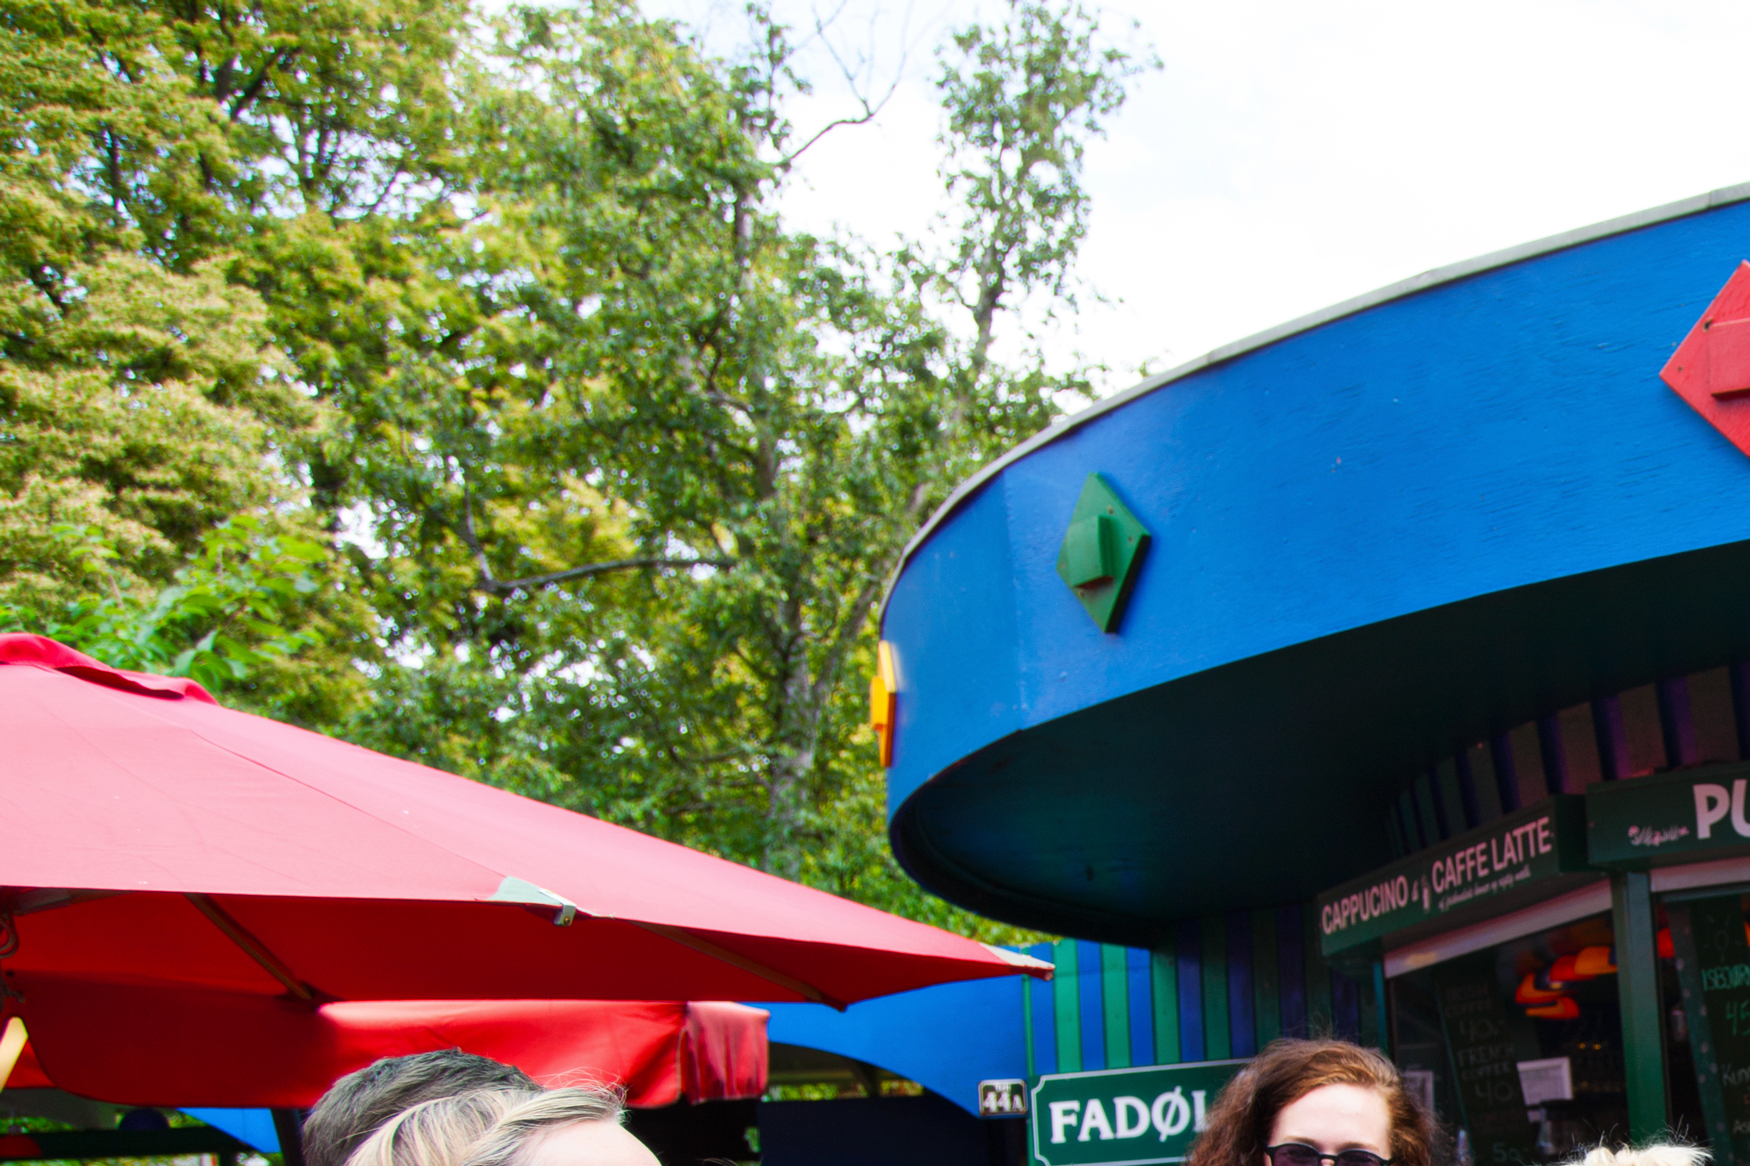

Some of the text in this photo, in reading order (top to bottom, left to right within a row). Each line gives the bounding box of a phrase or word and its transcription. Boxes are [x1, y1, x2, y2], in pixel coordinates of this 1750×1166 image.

[1322, 875, 1408, 935] CAPPUCINO
[1432, 841, 1489, 894] CAFFE
[1491, 816, 1553, 872] LATTE
